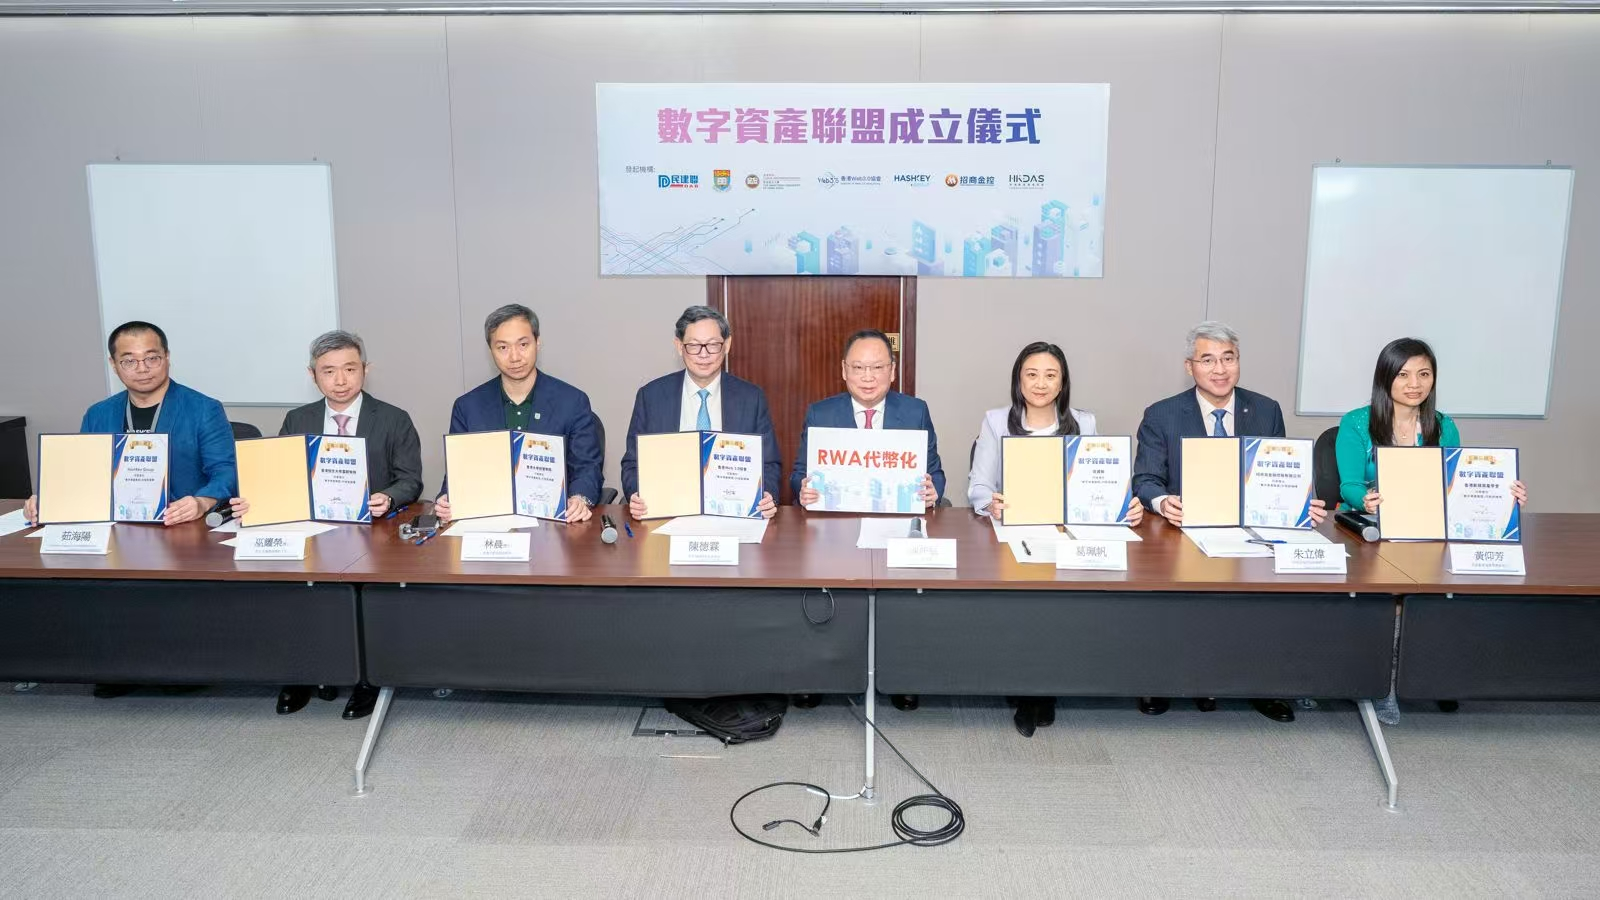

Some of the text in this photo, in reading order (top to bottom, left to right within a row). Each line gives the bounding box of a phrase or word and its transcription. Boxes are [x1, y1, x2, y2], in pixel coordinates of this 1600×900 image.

[656, 107, 1042, 144] 數字資產聯盟成立儀式
[671, 175, 699, 184] 民建聯
[960, 176, 995, 184] 招商金控
[1009, 174, 1045, 183] HKDAS
[817, 449, 917, 469] RWA代幣化
[484, 538, 503, 550] 林晨
[1293, 548, 1325, 559] 朱立偉
